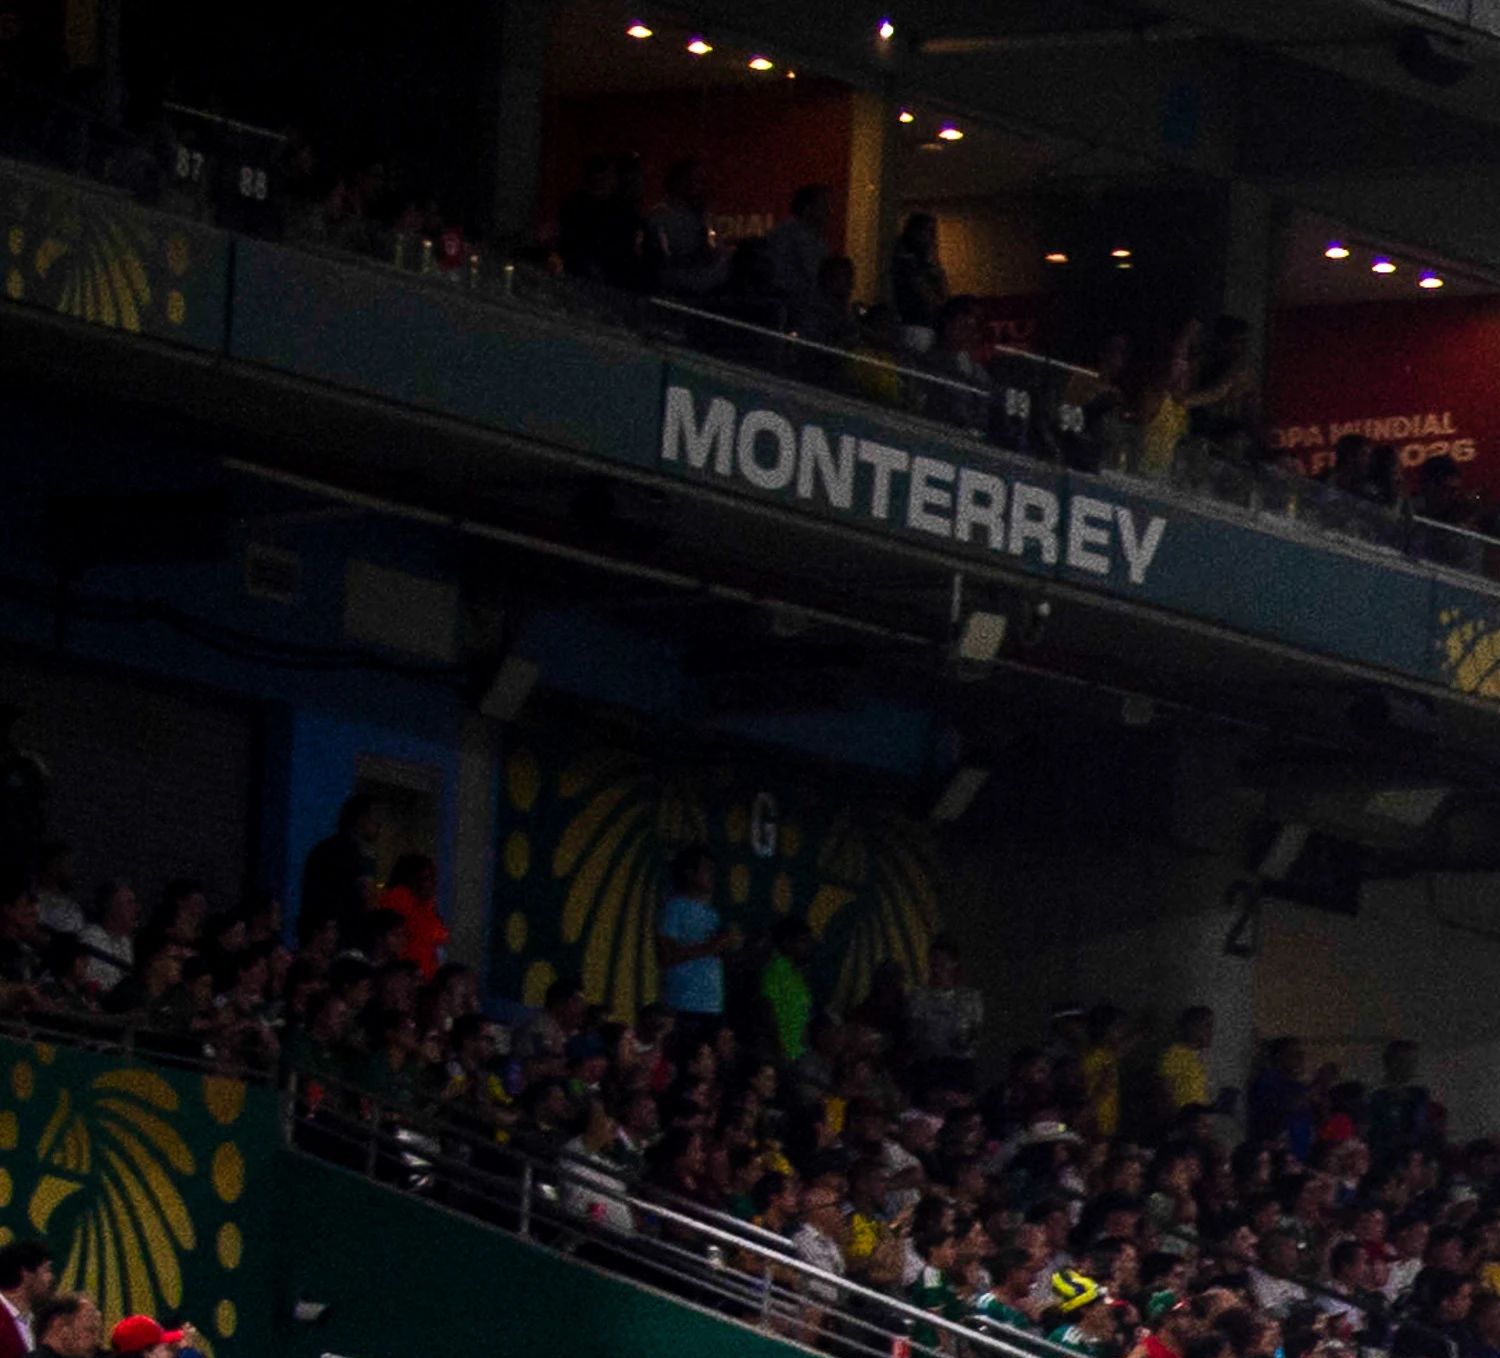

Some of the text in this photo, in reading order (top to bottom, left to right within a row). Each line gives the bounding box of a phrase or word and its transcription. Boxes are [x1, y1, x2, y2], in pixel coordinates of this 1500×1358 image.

[662, 384, 1167, 586] MONTERREY
[1399, 438, 1478, 468] 026
[750, 791, 777, 858] G
